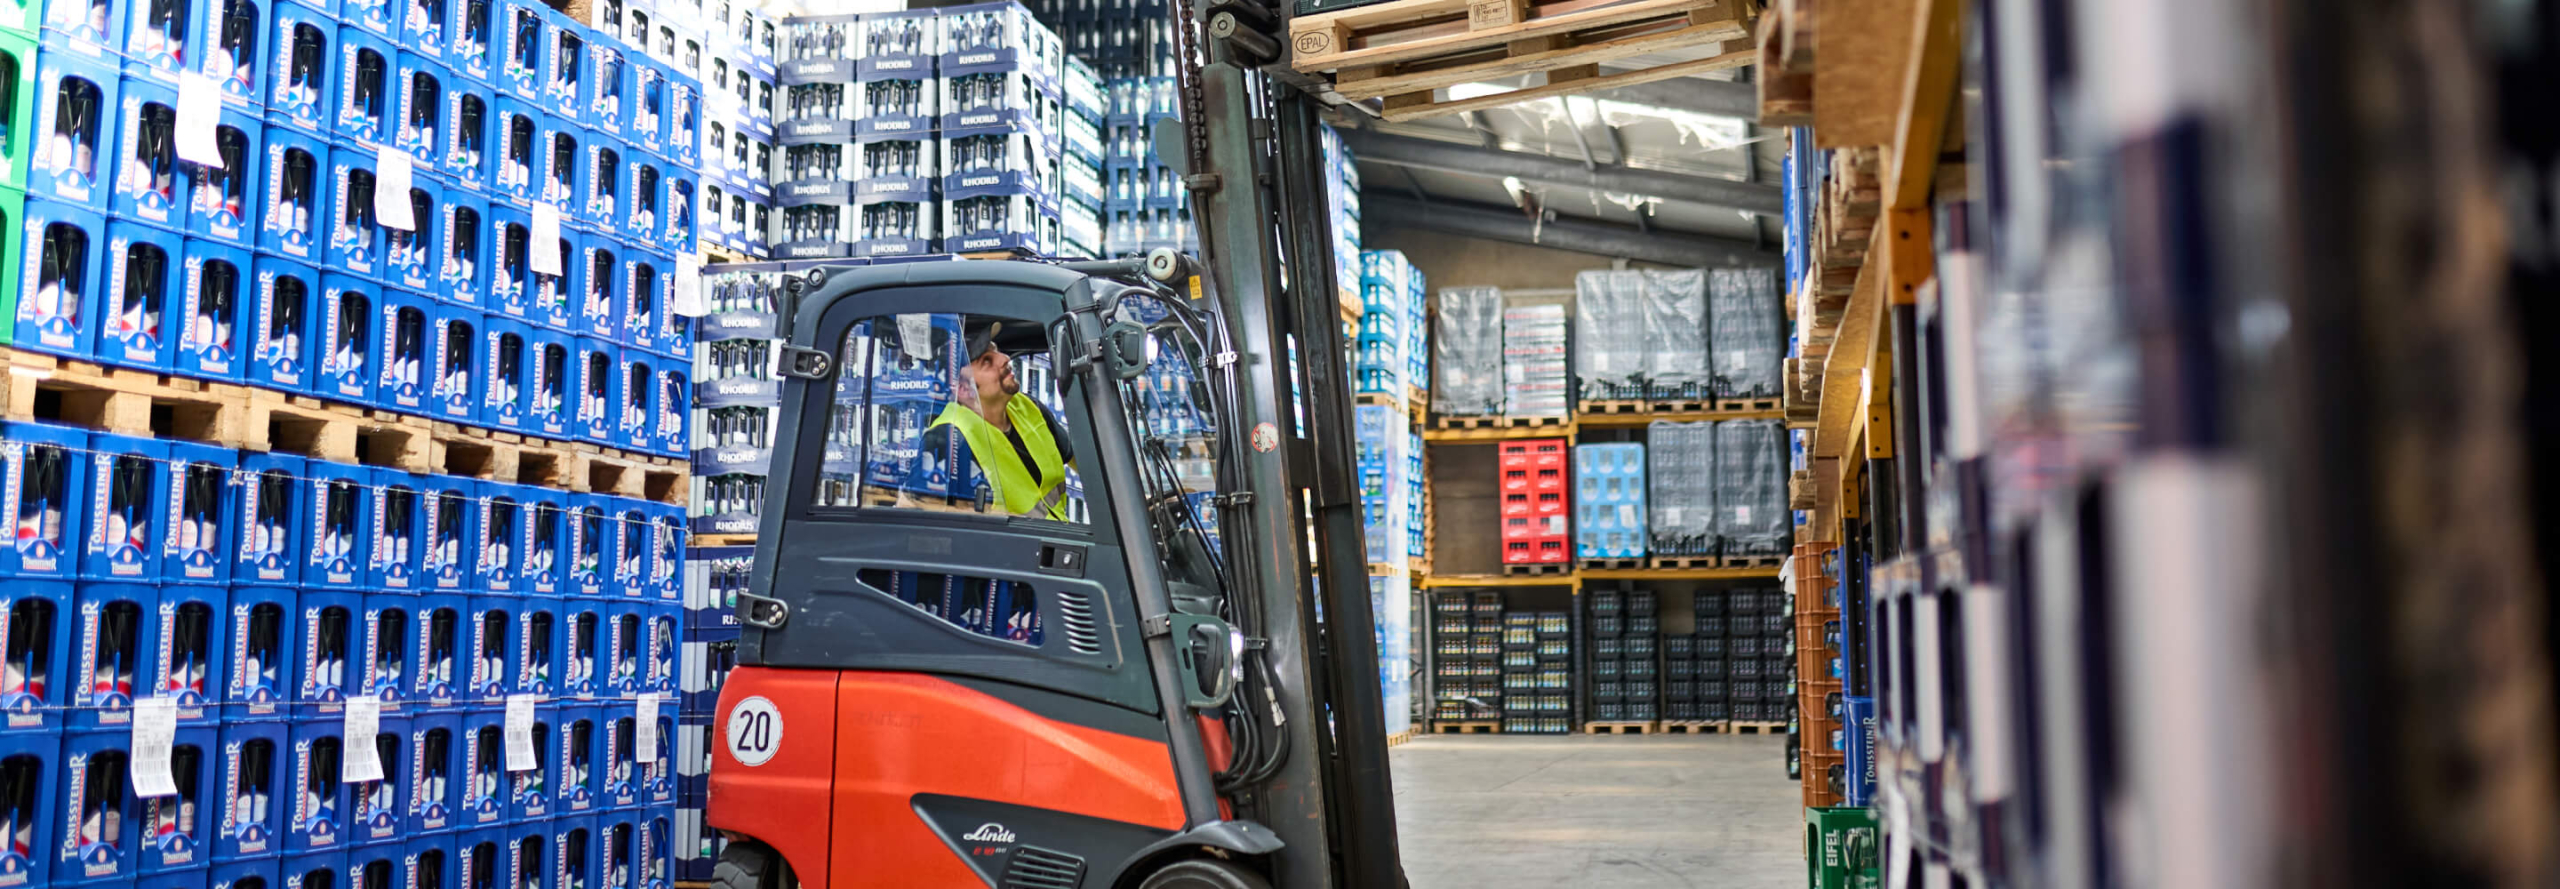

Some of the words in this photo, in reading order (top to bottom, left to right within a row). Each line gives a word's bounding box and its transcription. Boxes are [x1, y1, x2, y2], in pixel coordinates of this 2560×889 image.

[1300, 35, 1325, 50] EPAL
[876, 59, 911, 69] RHODIUS
[959, 53, 995, 64] RHODIUS
[799, 63, 834, 73] RHODIUS
[961, 114, 997, 125] RHODIUS
[797, 123, 832, 134] RHODIUS
[874, 120, 910, 131] RHODIUS
[873, 181, 909, 192] RHODIUS
[962, 176, 999, 187] RHODIUS
[794, 185, 830, 194] RHODIUS
[871, 244, 907, 254] RHODIUS
[964, 238, 1000, 249] RHODIUS
[792, 246, 828, 256] RHODIUS
[722, 318, 760, 328] RHODIUS
[719, 384, 758, 395] RHODIUS
[891, 380, 929, 390] RHODIUS
[717, 452, 755, 462] RHODIUS
[715, 521, 754, 531] RHODIUS
[737, 710, 771, 752] 20
[963, 823, 1016, 843] Linde
[1825, 830, 1838, 867] EIFEL
